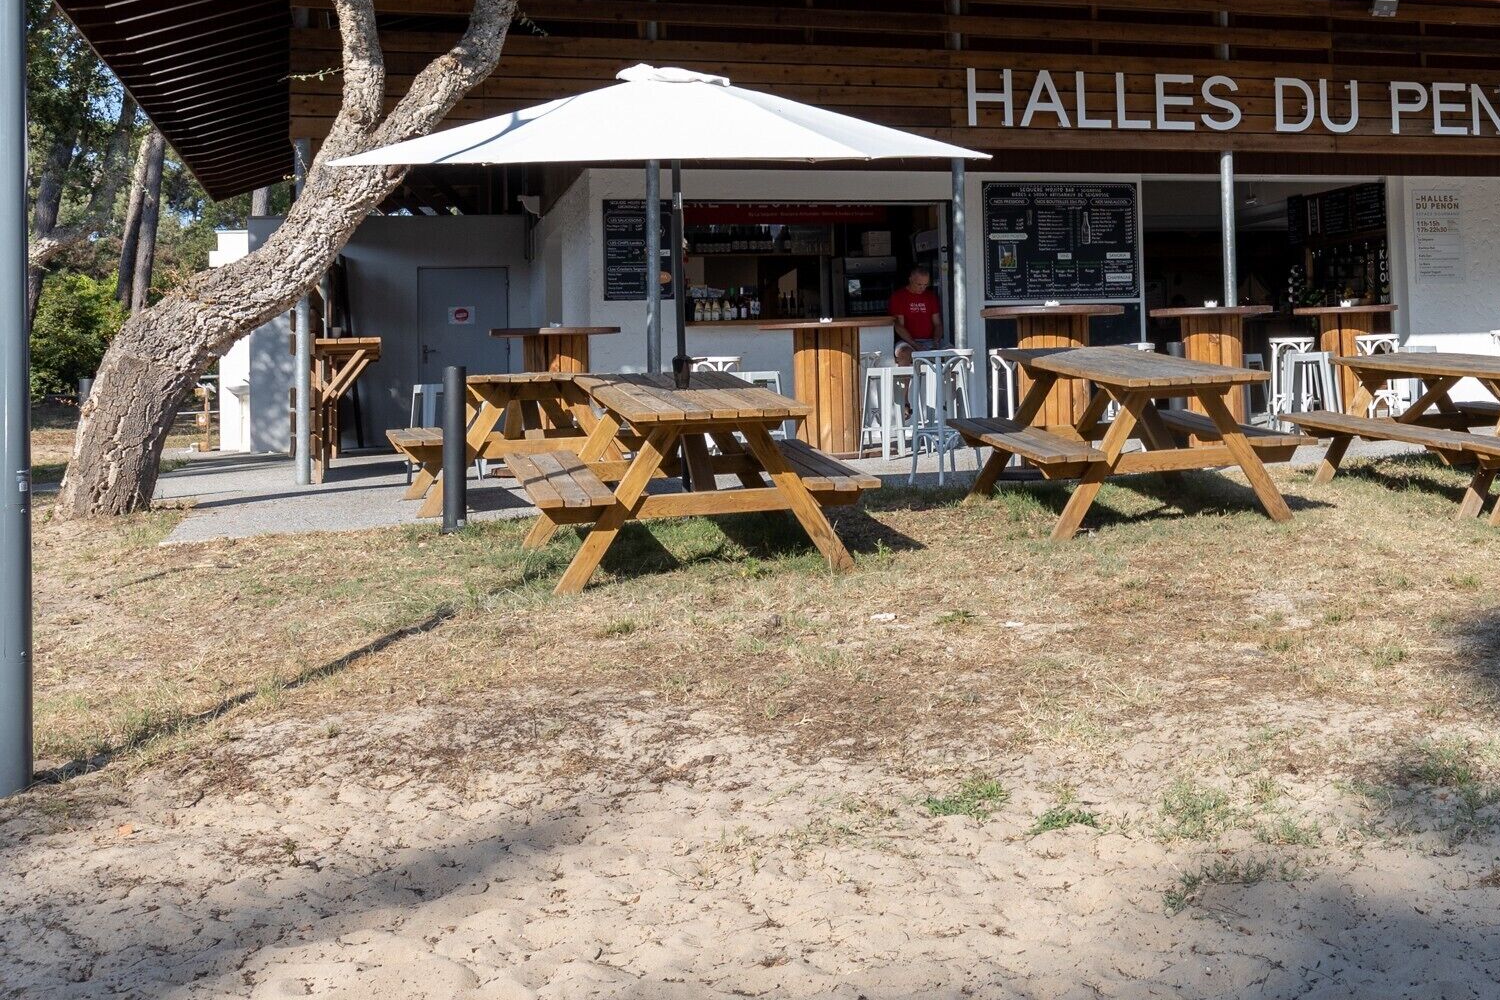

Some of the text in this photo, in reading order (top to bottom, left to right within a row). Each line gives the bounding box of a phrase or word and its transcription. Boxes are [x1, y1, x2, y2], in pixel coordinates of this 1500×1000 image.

[967, 67, 1243, 131] HALLES
[1274, 76, 1359, 134] DU
[1431, 202, 1459, 210] PENON
